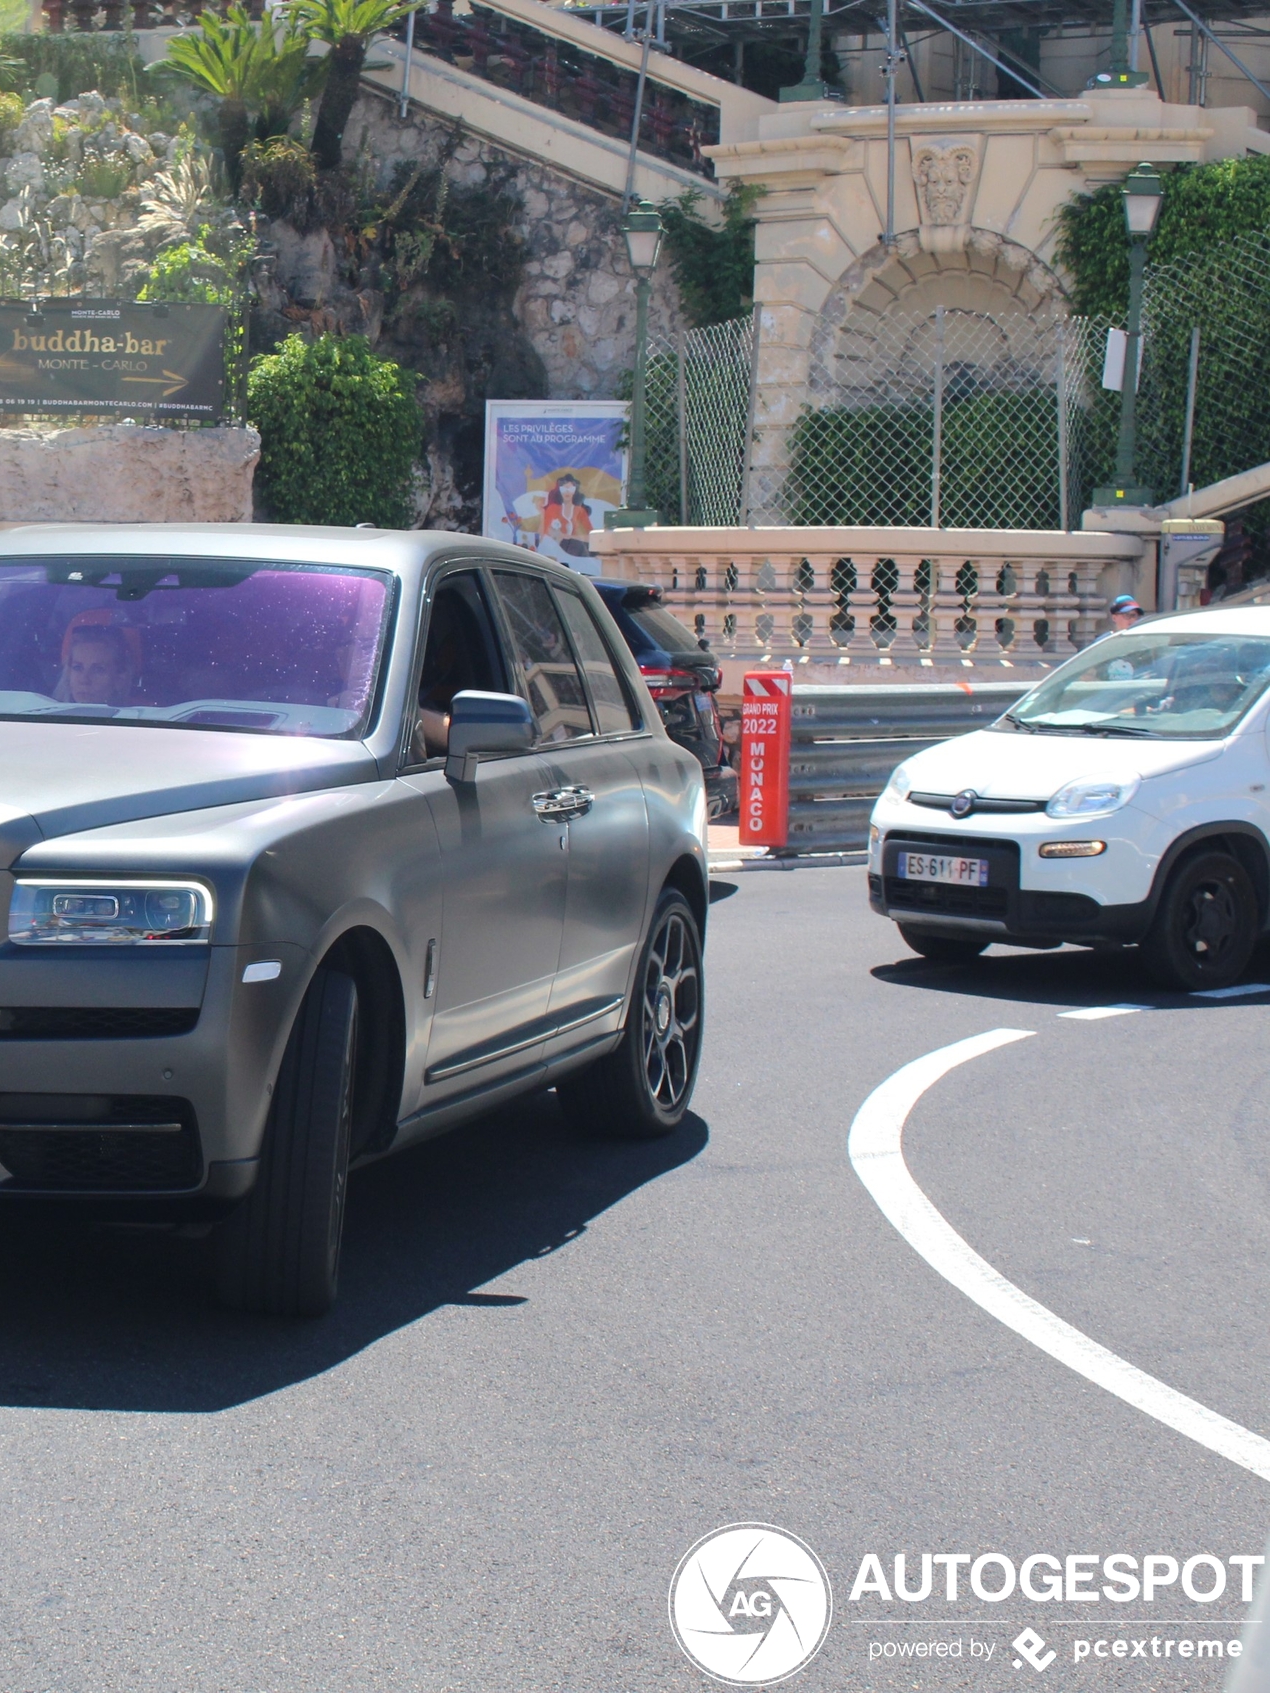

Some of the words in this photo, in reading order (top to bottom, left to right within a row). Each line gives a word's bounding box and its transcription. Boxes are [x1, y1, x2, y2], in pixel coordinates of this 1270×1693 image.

[12, 328, 167, 355] buddha-bar
[38, 359, 89, 370] MONTE
[101, 359, 148, 371] CARLO
[42, 399, 153, 408] BUDDHABARMONTECARLO.COM
[158, 402, 213, 411] #BUDDHABARMC
[503, 424, 519, 433] LES
[521, 422, 573, 433] PRIVILÈGES
[503, 434, 529, 443] SONT
[530, 435, 543, 443] AU
[544, 434, 606, 443] PROGRAMME
[743, 703, 762, 715] GRAND
[762, 703, 779, 716] PRIX
[742, 718, 777, 734] 2022
[749, 742, 765, 832] MONACO
